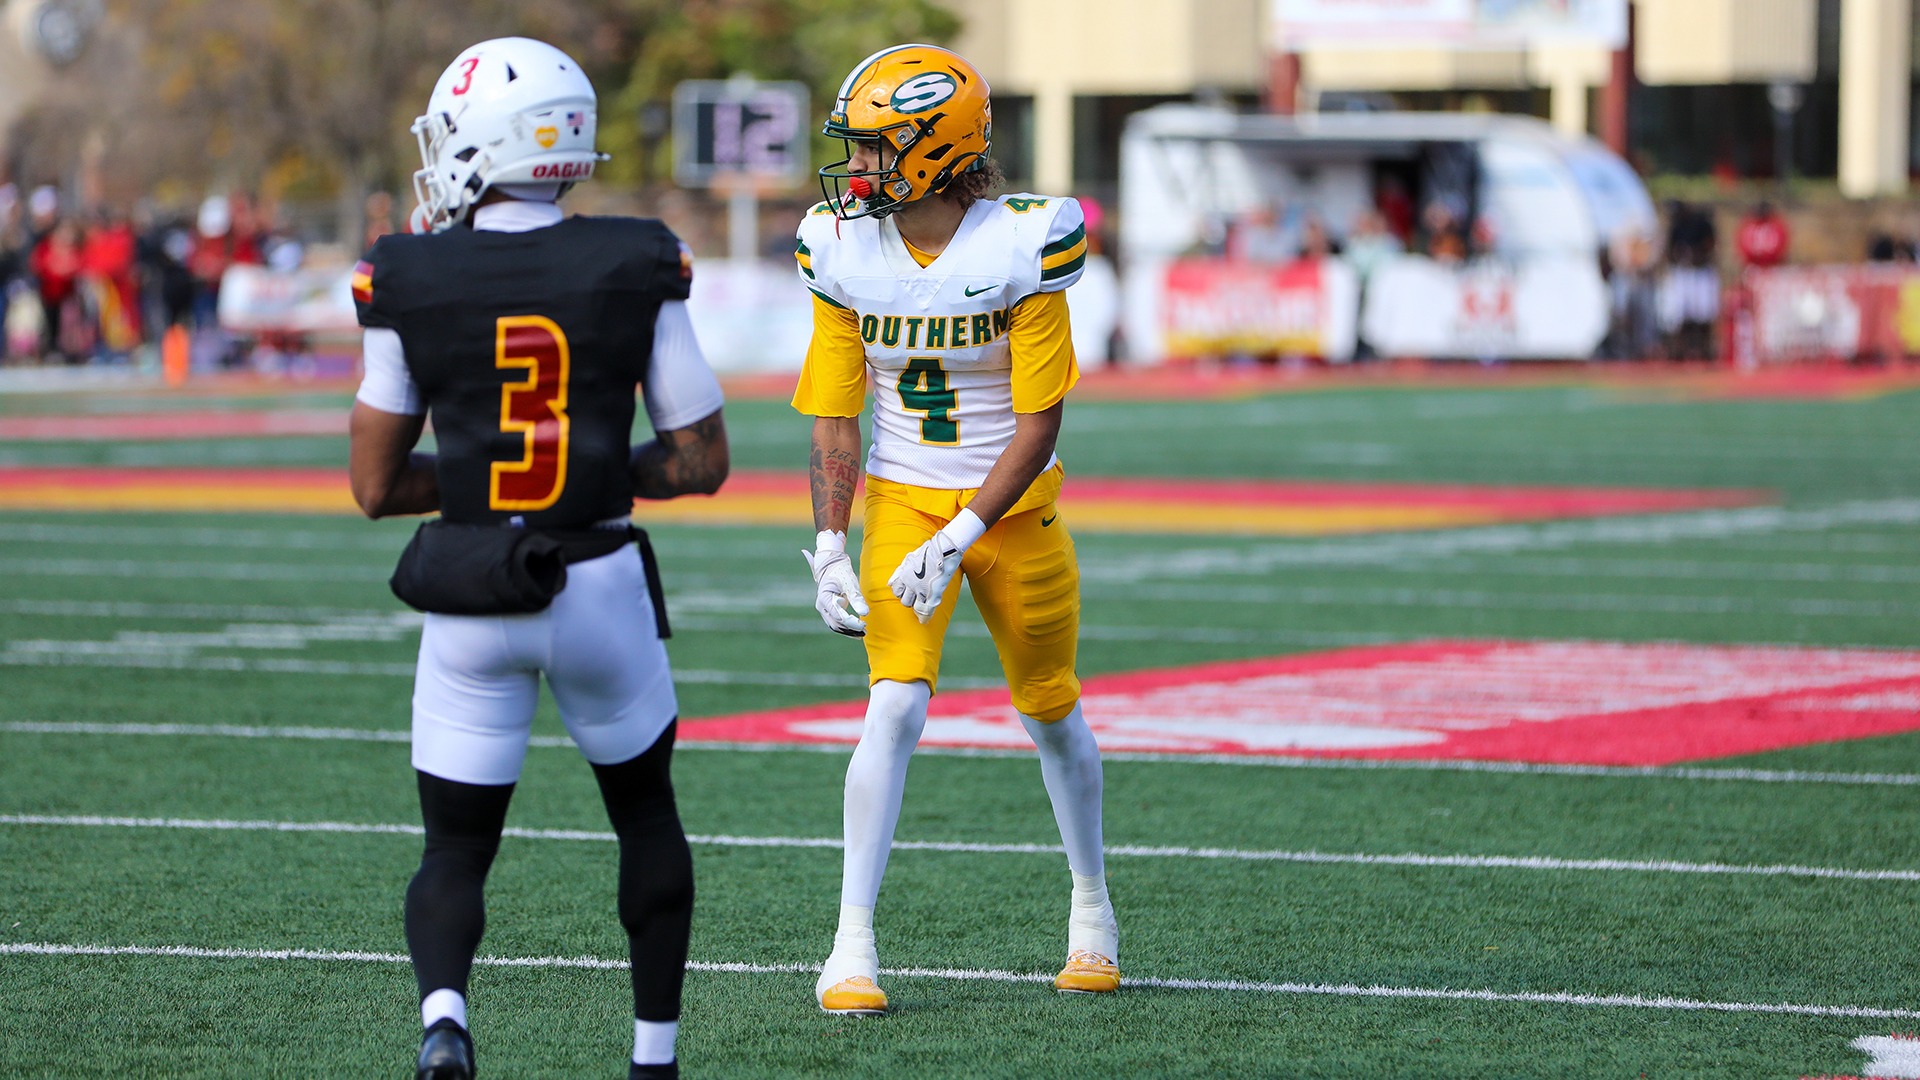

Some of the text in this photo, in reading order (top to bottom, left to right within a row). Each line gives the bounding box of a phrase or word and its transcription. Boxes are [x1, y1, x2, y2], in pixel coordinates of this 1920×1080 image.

[452, 55, 479, 96] 3
[894, 72, 956, 111] S
[1003, 196, 1049, 215] 4
[851, 306, 1011, 350] OUTHERN
[489, 315, 571, 511] 3
[895, 356, 960, 447] 4
[826, 447, 853, 462] Let
